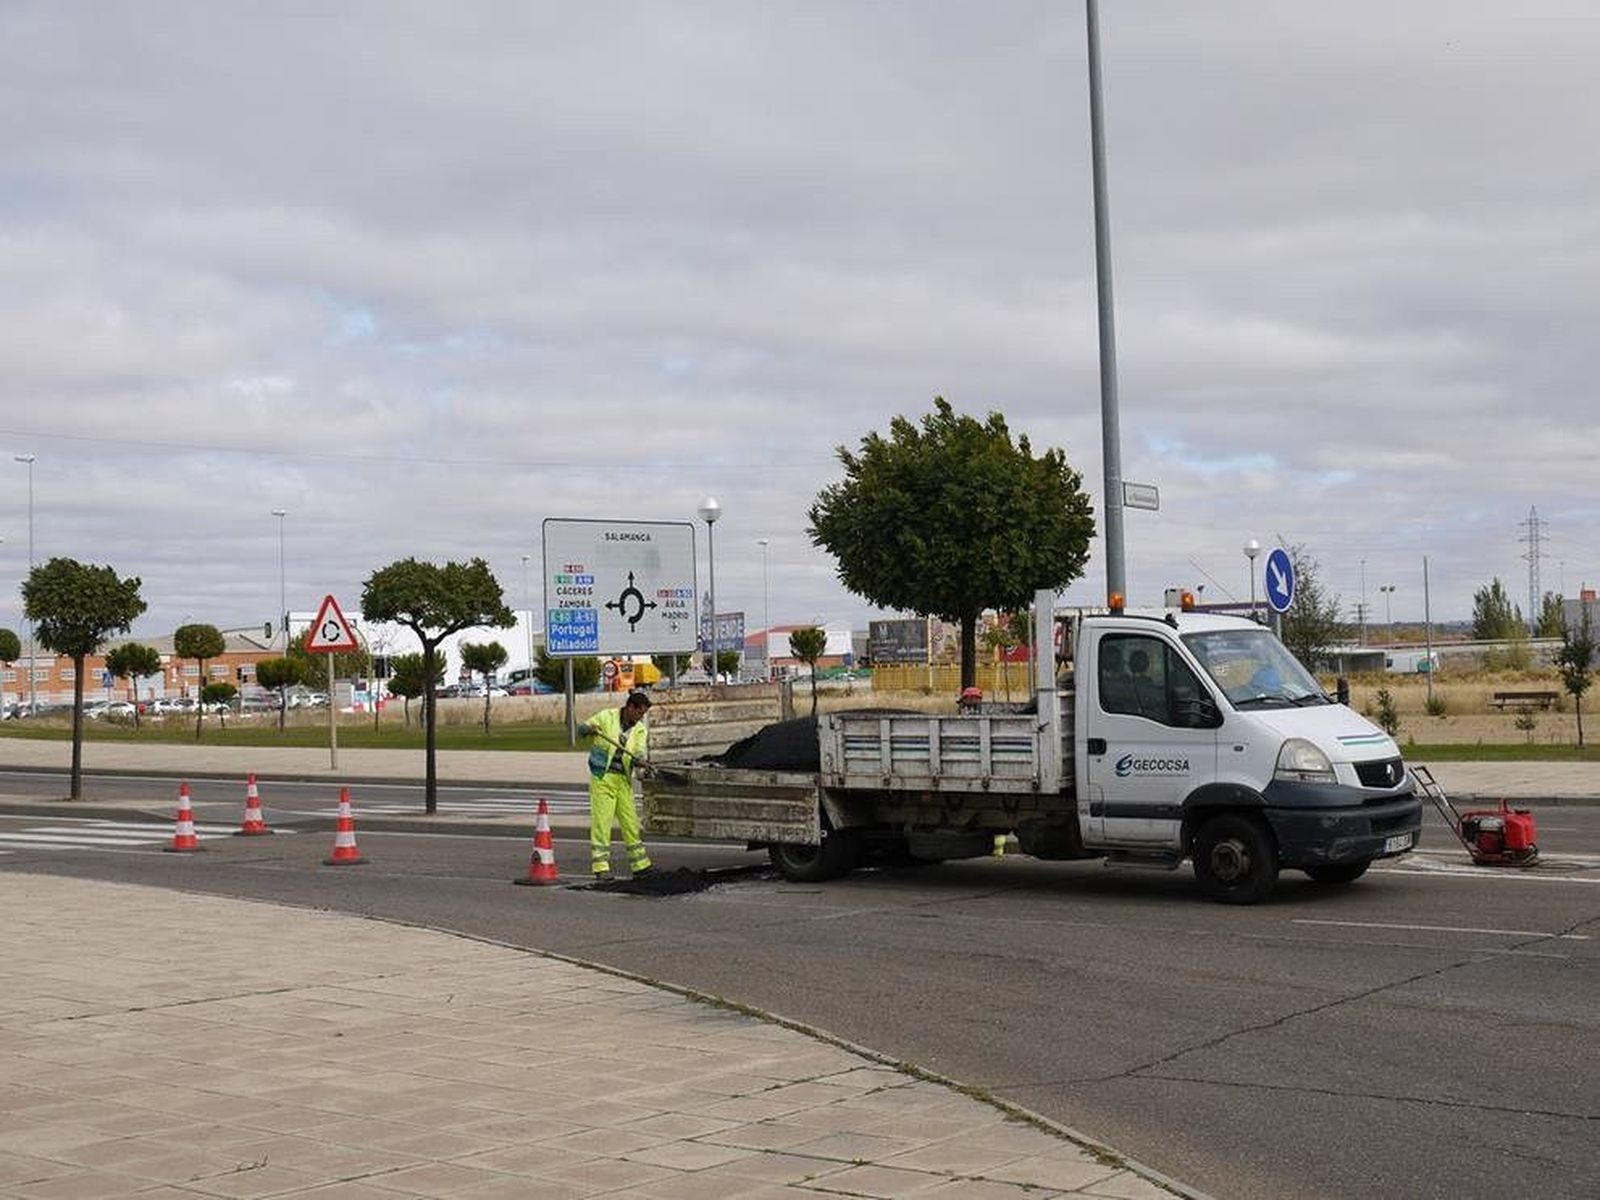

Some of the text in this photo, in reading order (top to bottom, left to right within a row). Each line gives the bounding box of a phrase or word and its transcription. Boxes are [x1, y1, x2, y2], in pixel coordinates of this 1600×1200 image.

[604, 532, 652, 542] SALAMANCA
[559, 600, 592, 608] ZAMORA
[661, 611, 688, 620] MADRID
[551, 624, 595, 637] Portugal
[550, 638, 597, 650] Valladolid
[1133, 759, 1190, 771] GECOCSA
